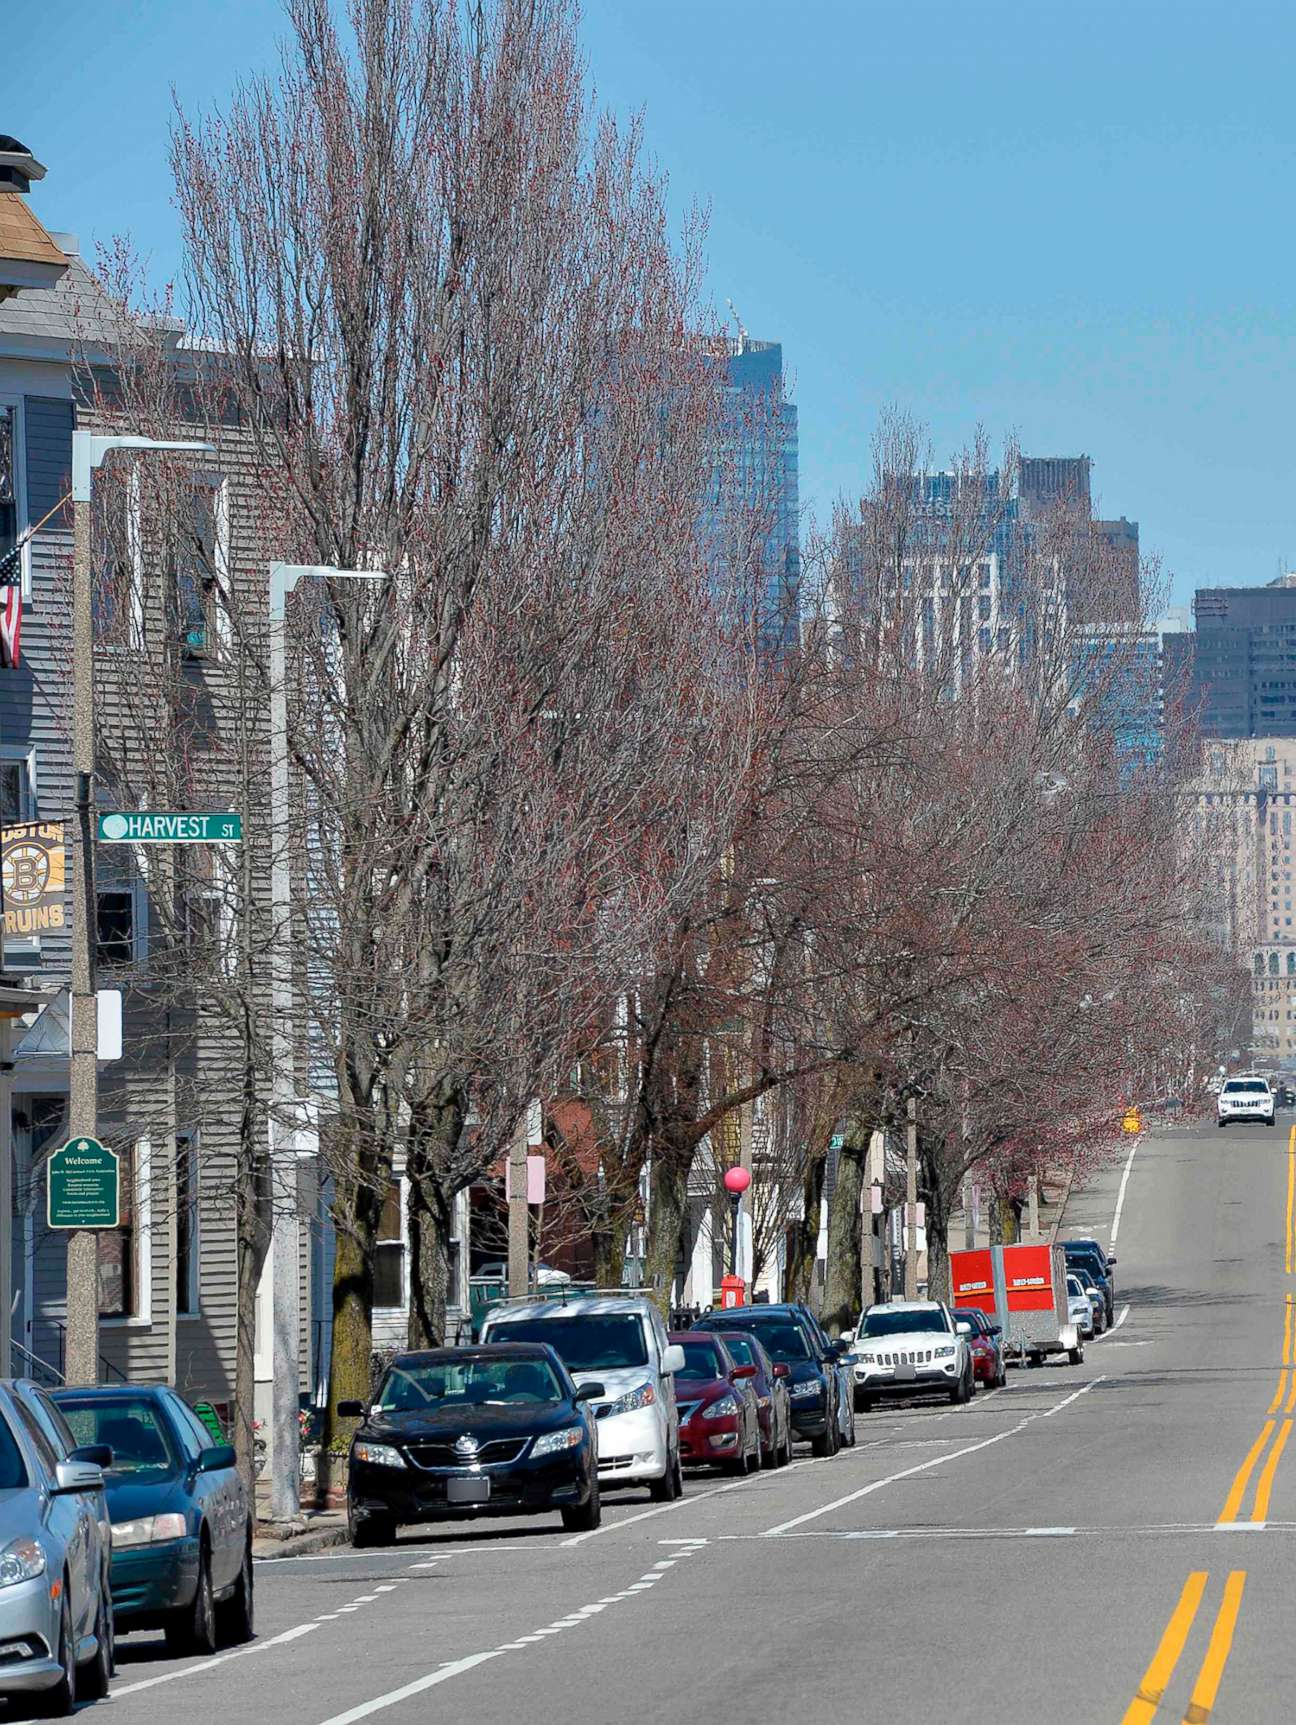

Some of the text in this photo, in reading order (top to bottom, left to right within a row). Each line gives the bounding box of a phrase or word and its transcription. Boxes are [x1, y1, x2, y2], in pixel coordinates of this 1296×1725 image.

[1, 822, 64, 843] OSTON
[129, 816, 233, 838] HARVEST ST
[4, 904, 64, 934] RUINS
[65, 1157, 103, 1166] Welcome
